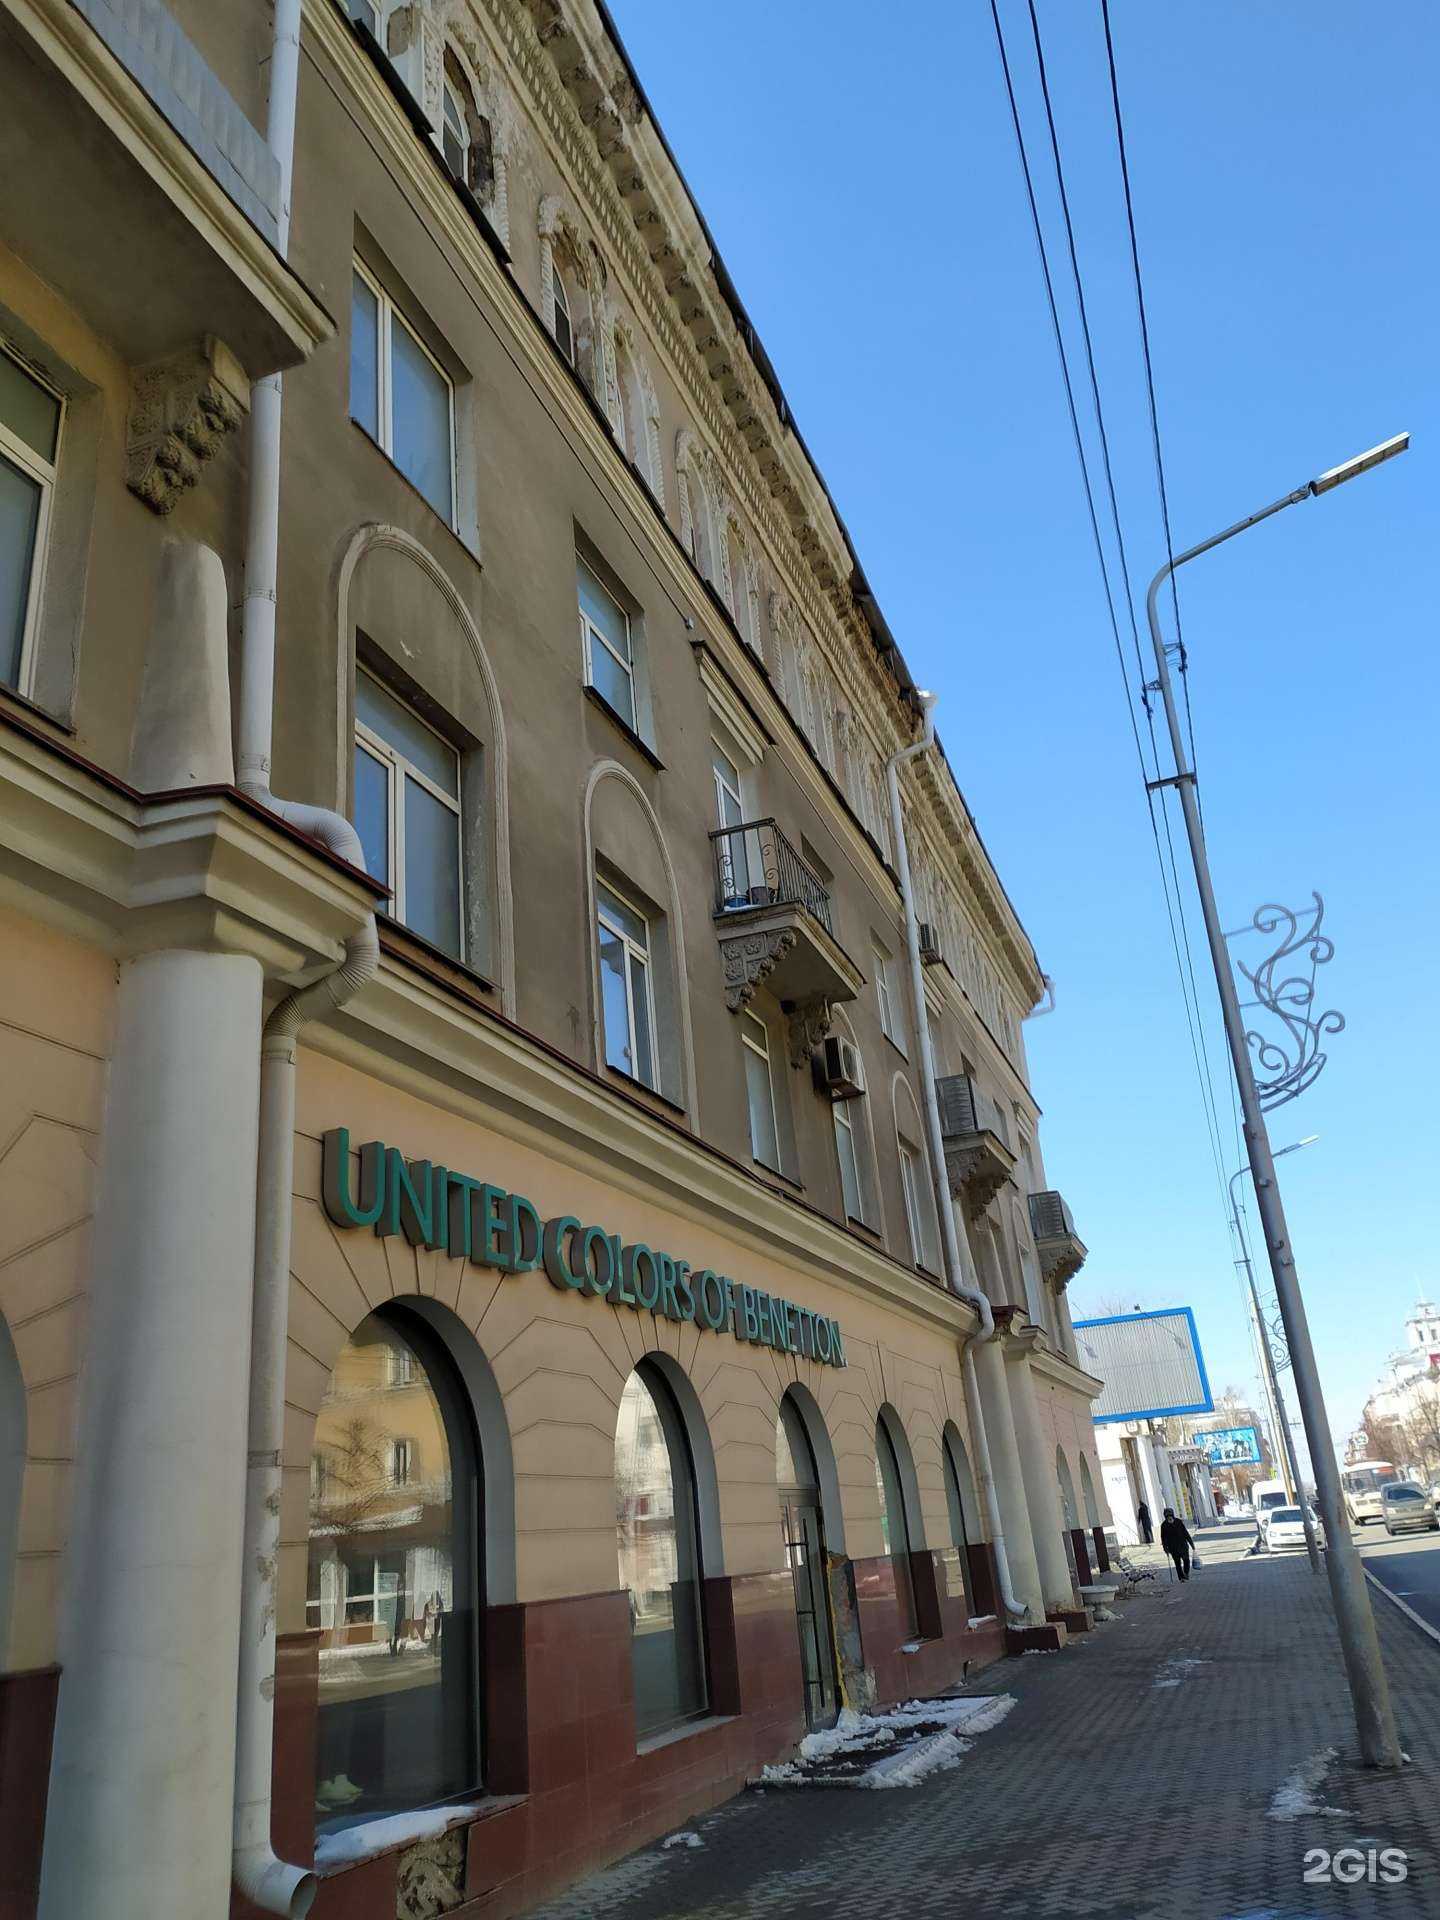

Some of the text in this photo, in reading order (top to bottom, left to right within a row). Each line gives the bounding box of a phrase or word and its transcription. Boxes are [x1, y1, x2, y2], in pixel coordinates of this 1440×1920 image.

[322, 1127, 542, 1273] UNITED
[543, 1216, 696, 1322] COLORS
[690, 1269, 736, 1334] OF
